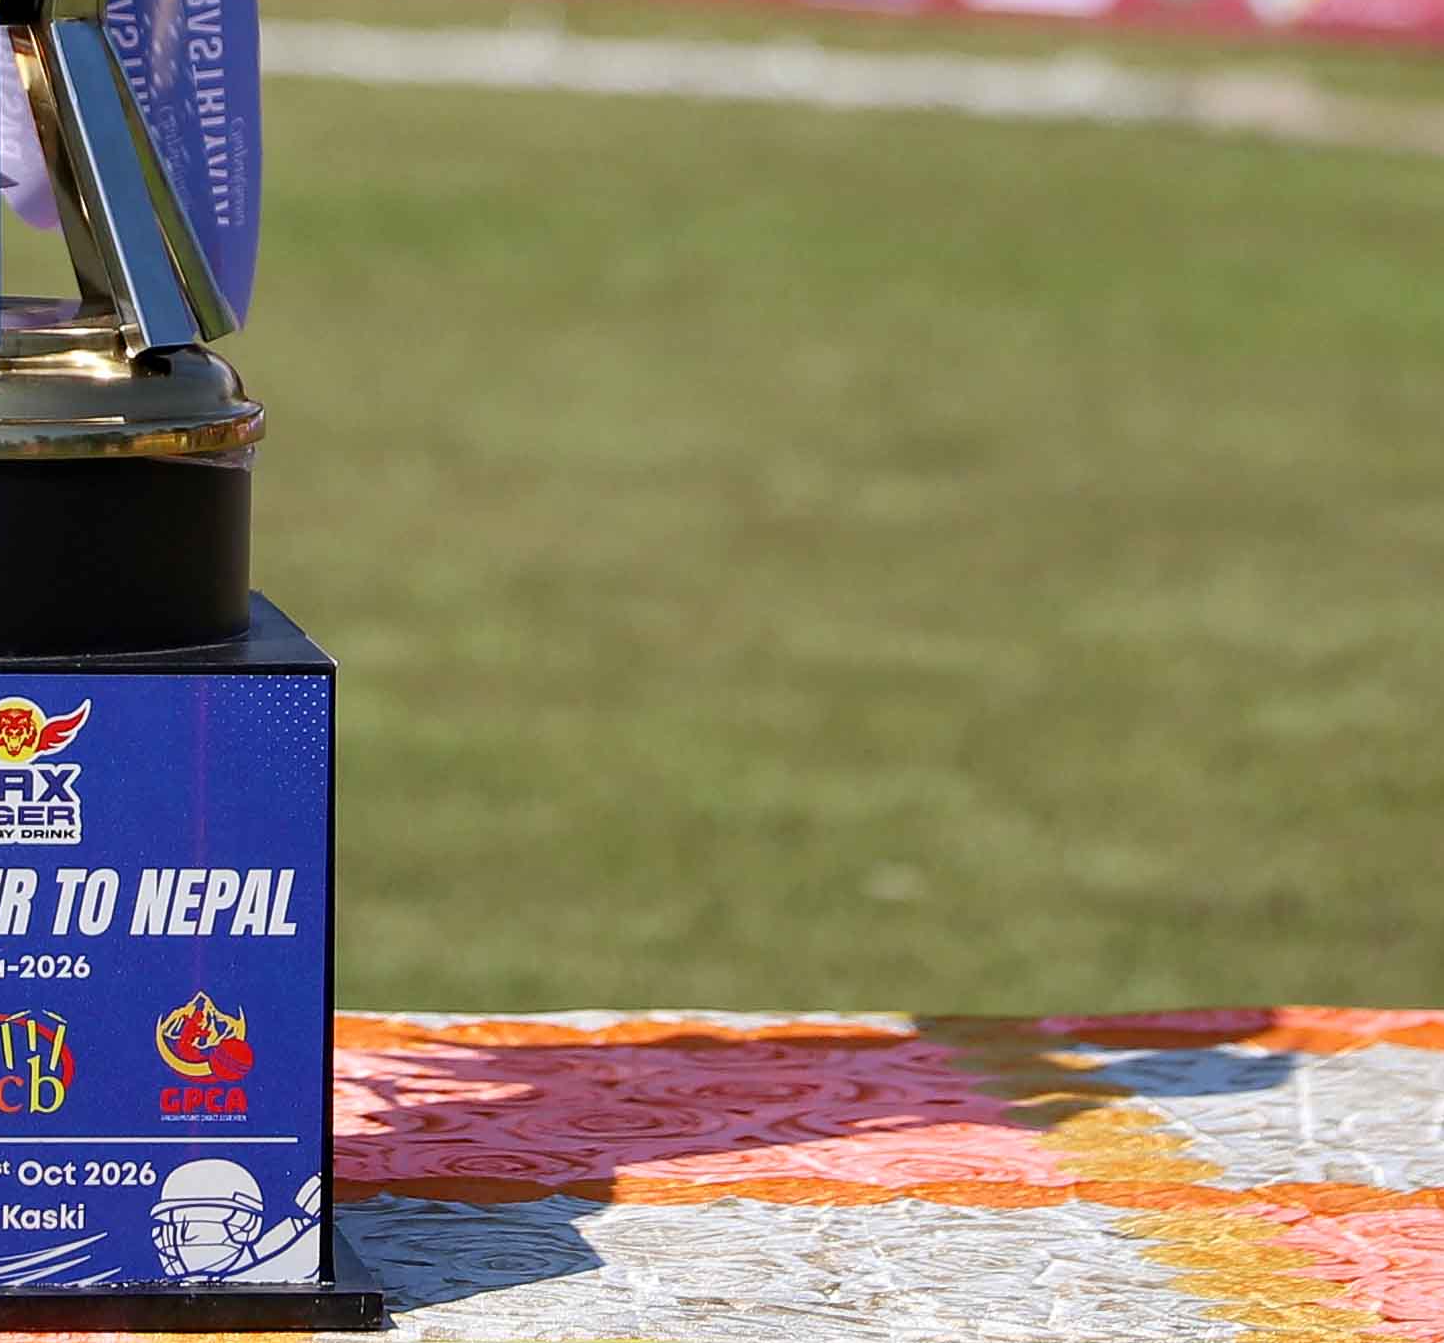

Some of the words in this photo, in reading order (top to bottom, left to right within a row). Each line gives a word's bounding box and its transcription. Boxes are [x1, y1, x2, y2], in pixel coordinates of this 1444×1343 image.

[21, 829, 76, 839] DRINK
[52, 867, 121, 937] TO
[130, 867, 298, 937] NEPAL
[160, 1087, 248, 1113] GPCA
[18, 1161, 76, 1186] Oct
[84, 1161, 157, 1186] 2026
[2, 1203, 85, 1230] Kaski
